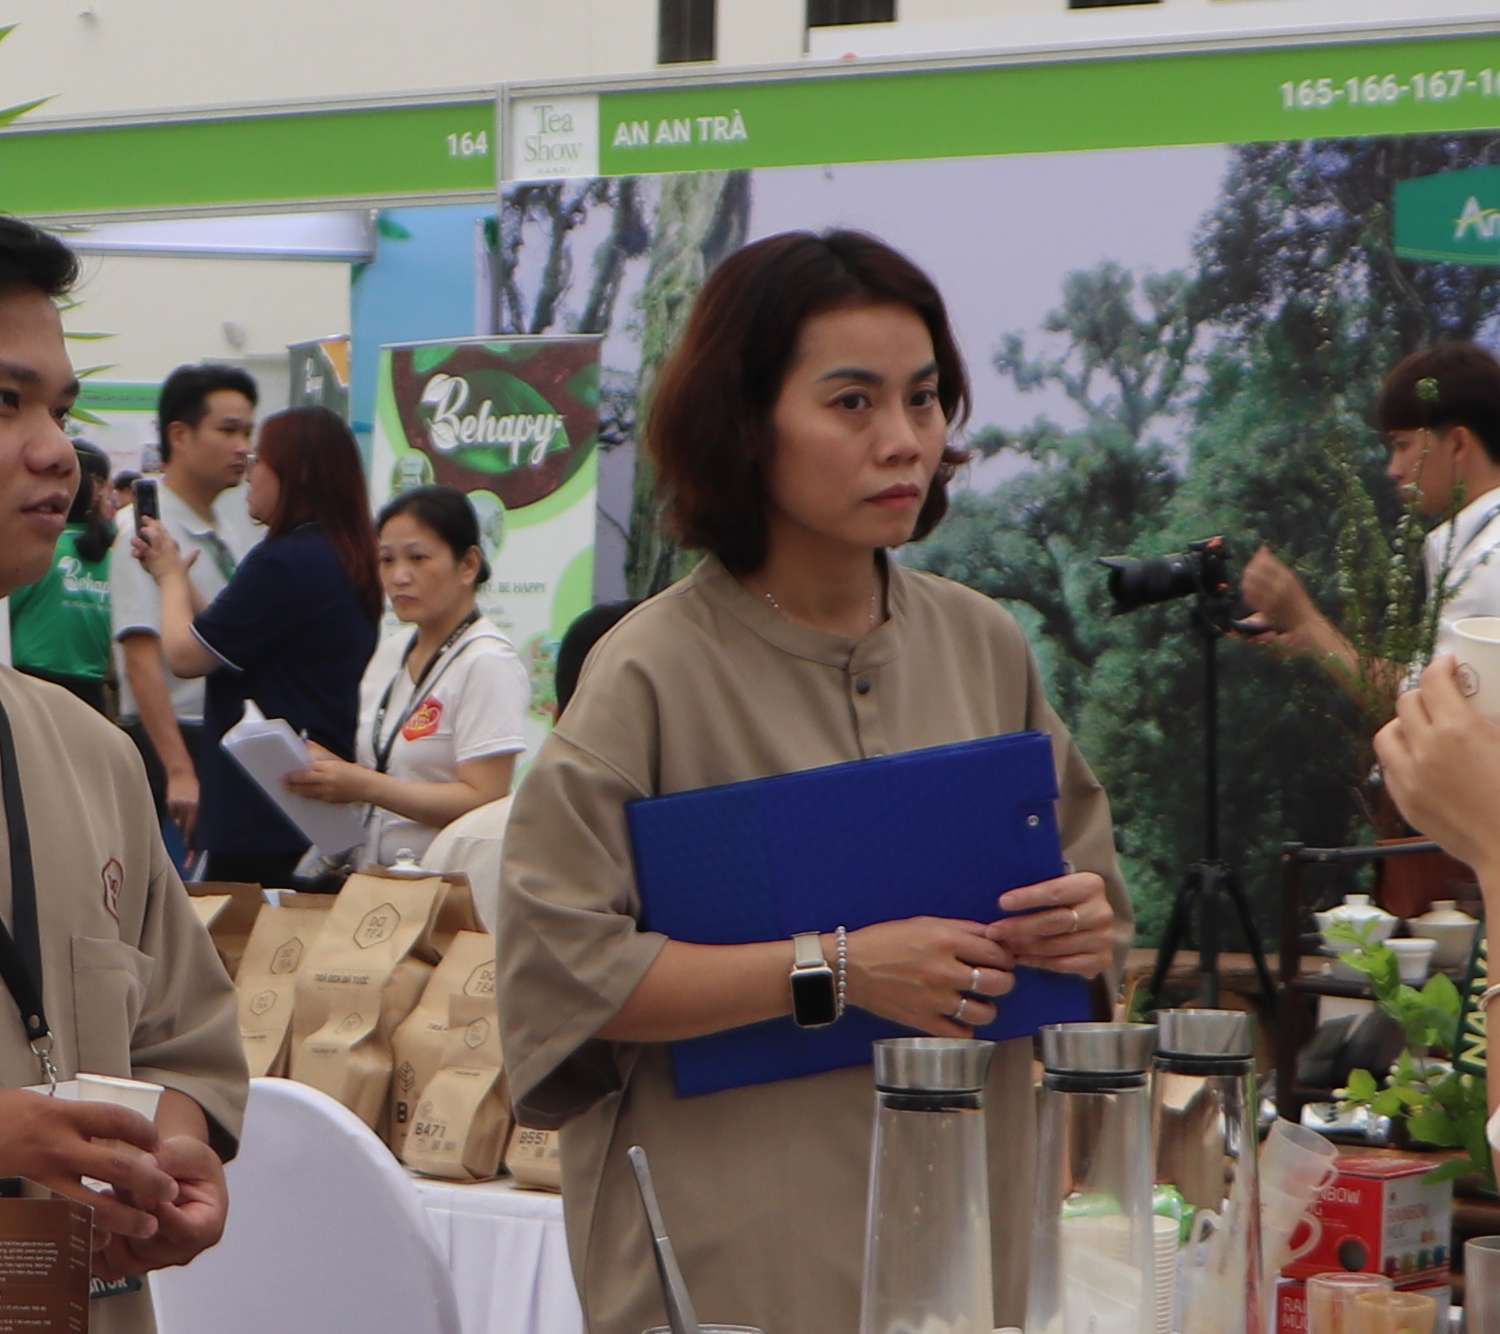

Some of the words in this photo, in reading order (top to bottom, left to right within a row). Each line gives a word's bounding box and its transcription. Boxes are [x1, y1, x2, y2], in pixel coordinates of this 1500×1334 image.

[534, 104, 574, 134] Tea
[613, 121, 650, 147] AN
[655, 118, 691, 145] AN
[696, 108, 748, 142] TRÀ
[447, 131, 488, 156] 164
[524, 135, 582, 162] Show
[420, 373, 564, 465] Behapy
[513, 582, 546, 593] HAPPY
